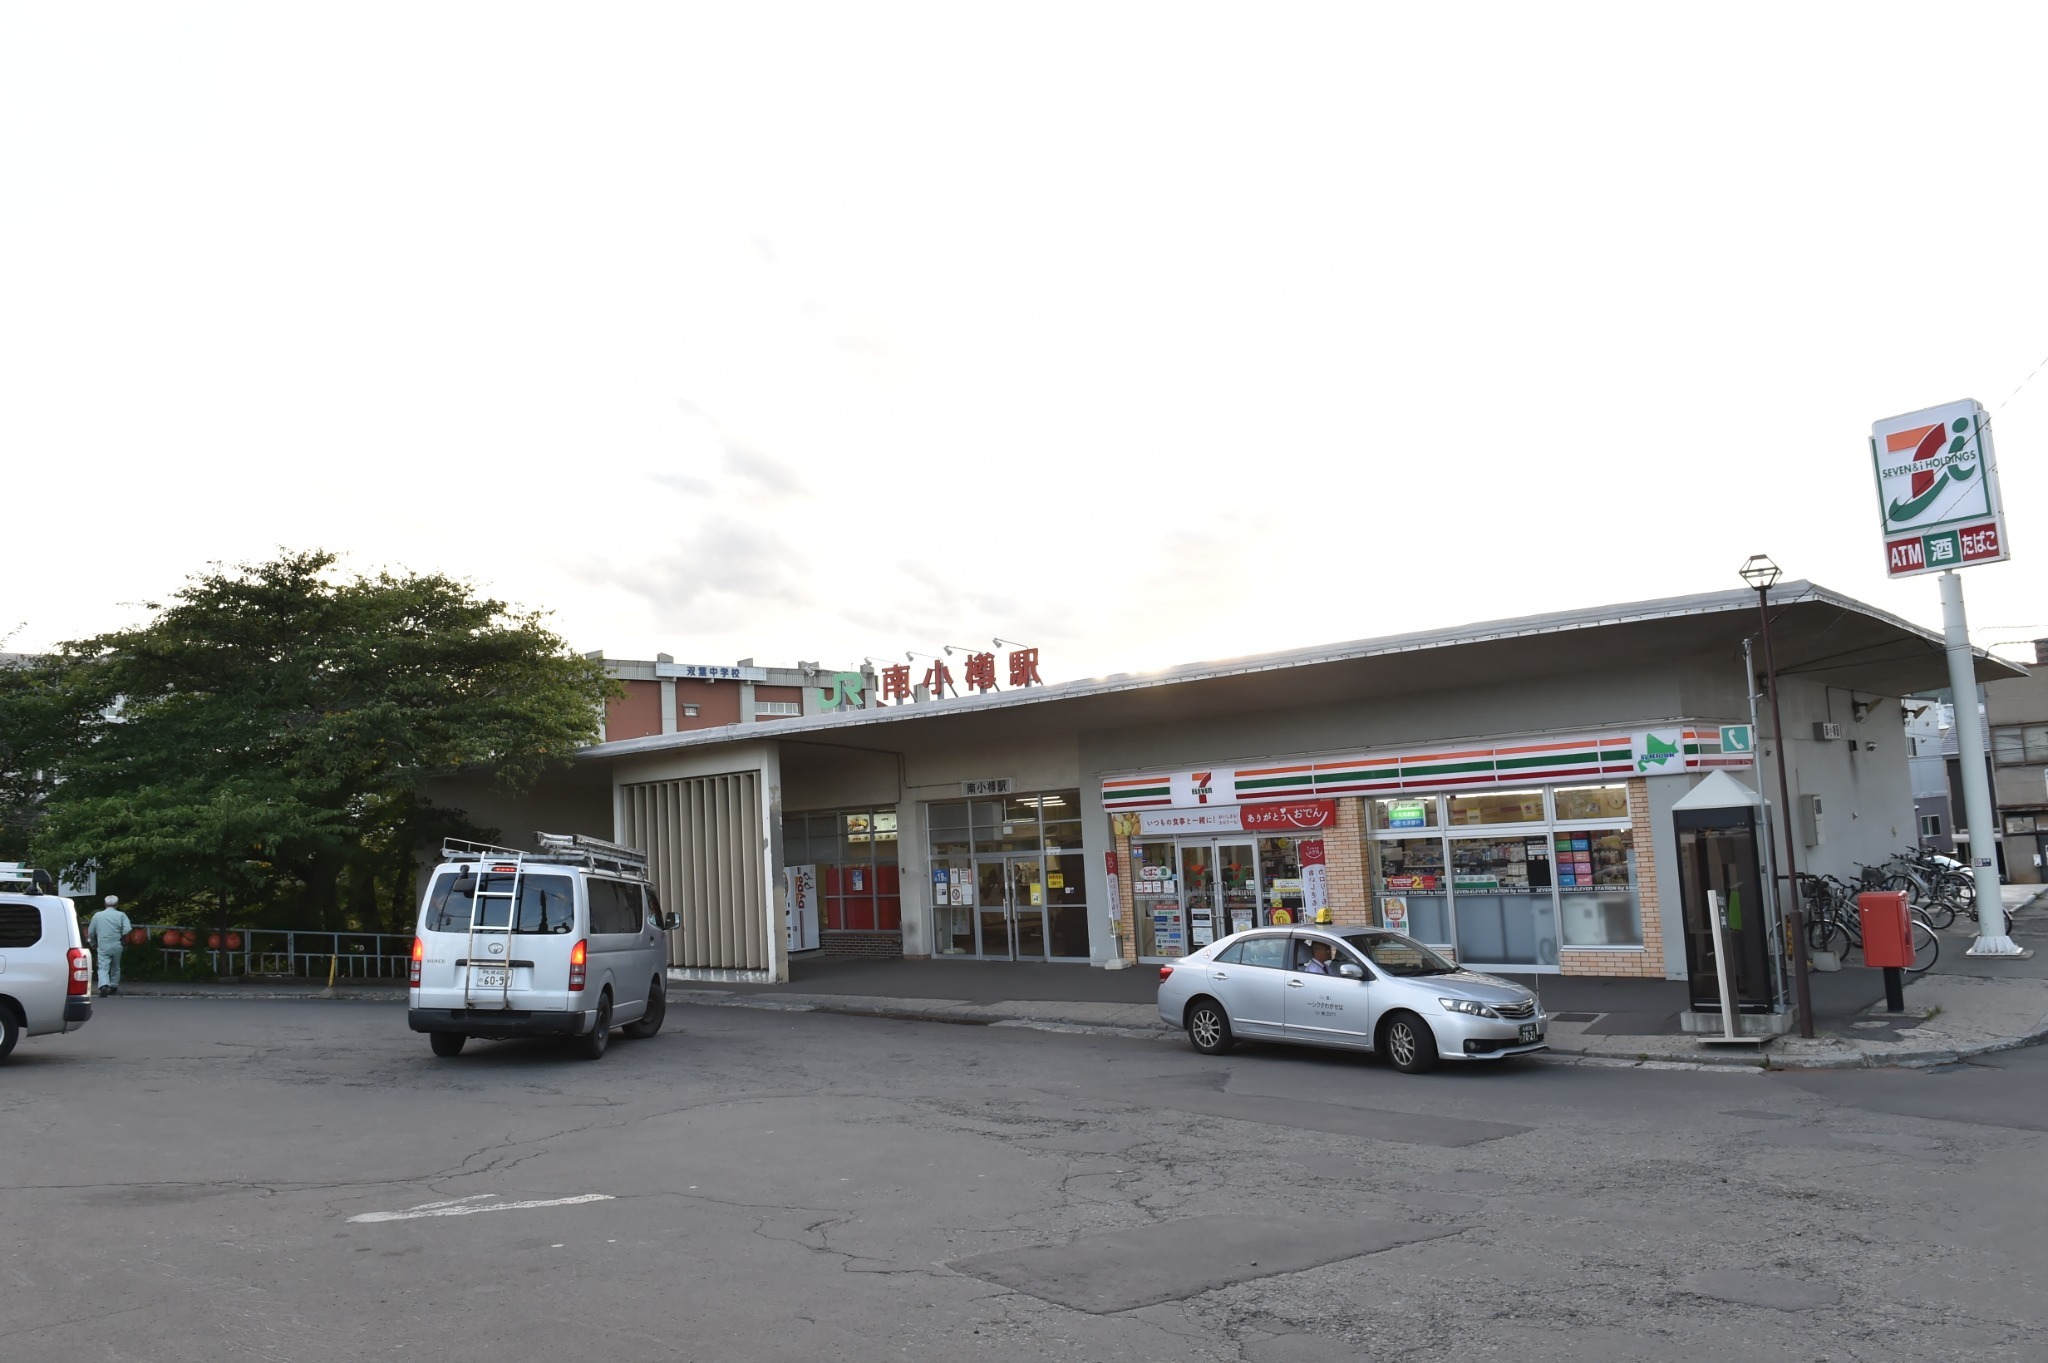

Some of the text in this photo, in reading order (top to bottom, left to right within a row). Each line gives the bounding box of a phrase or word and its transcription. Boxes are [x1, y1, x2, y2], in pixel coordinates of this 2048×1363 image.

[1926, 450, 1976, 467] HOLDINGS
[1930, 538, 1954, 562] 酒
[1962, 530, 1998, 556] たばこ
[1891, 543, 1923, 568] ATM
[686, 666, 740, 678] 双葉中学校
[882, 648, 1043, 701] 南小樽駅
[817, 671, 864, 709] JR
[966, 780, 1007, 794] 南小樽駅
[1247, 812, 1287, 823] ありがとう
[1294, 807, 1322, 819] おでん
[1143, 867, 1158, 877] たばこ
